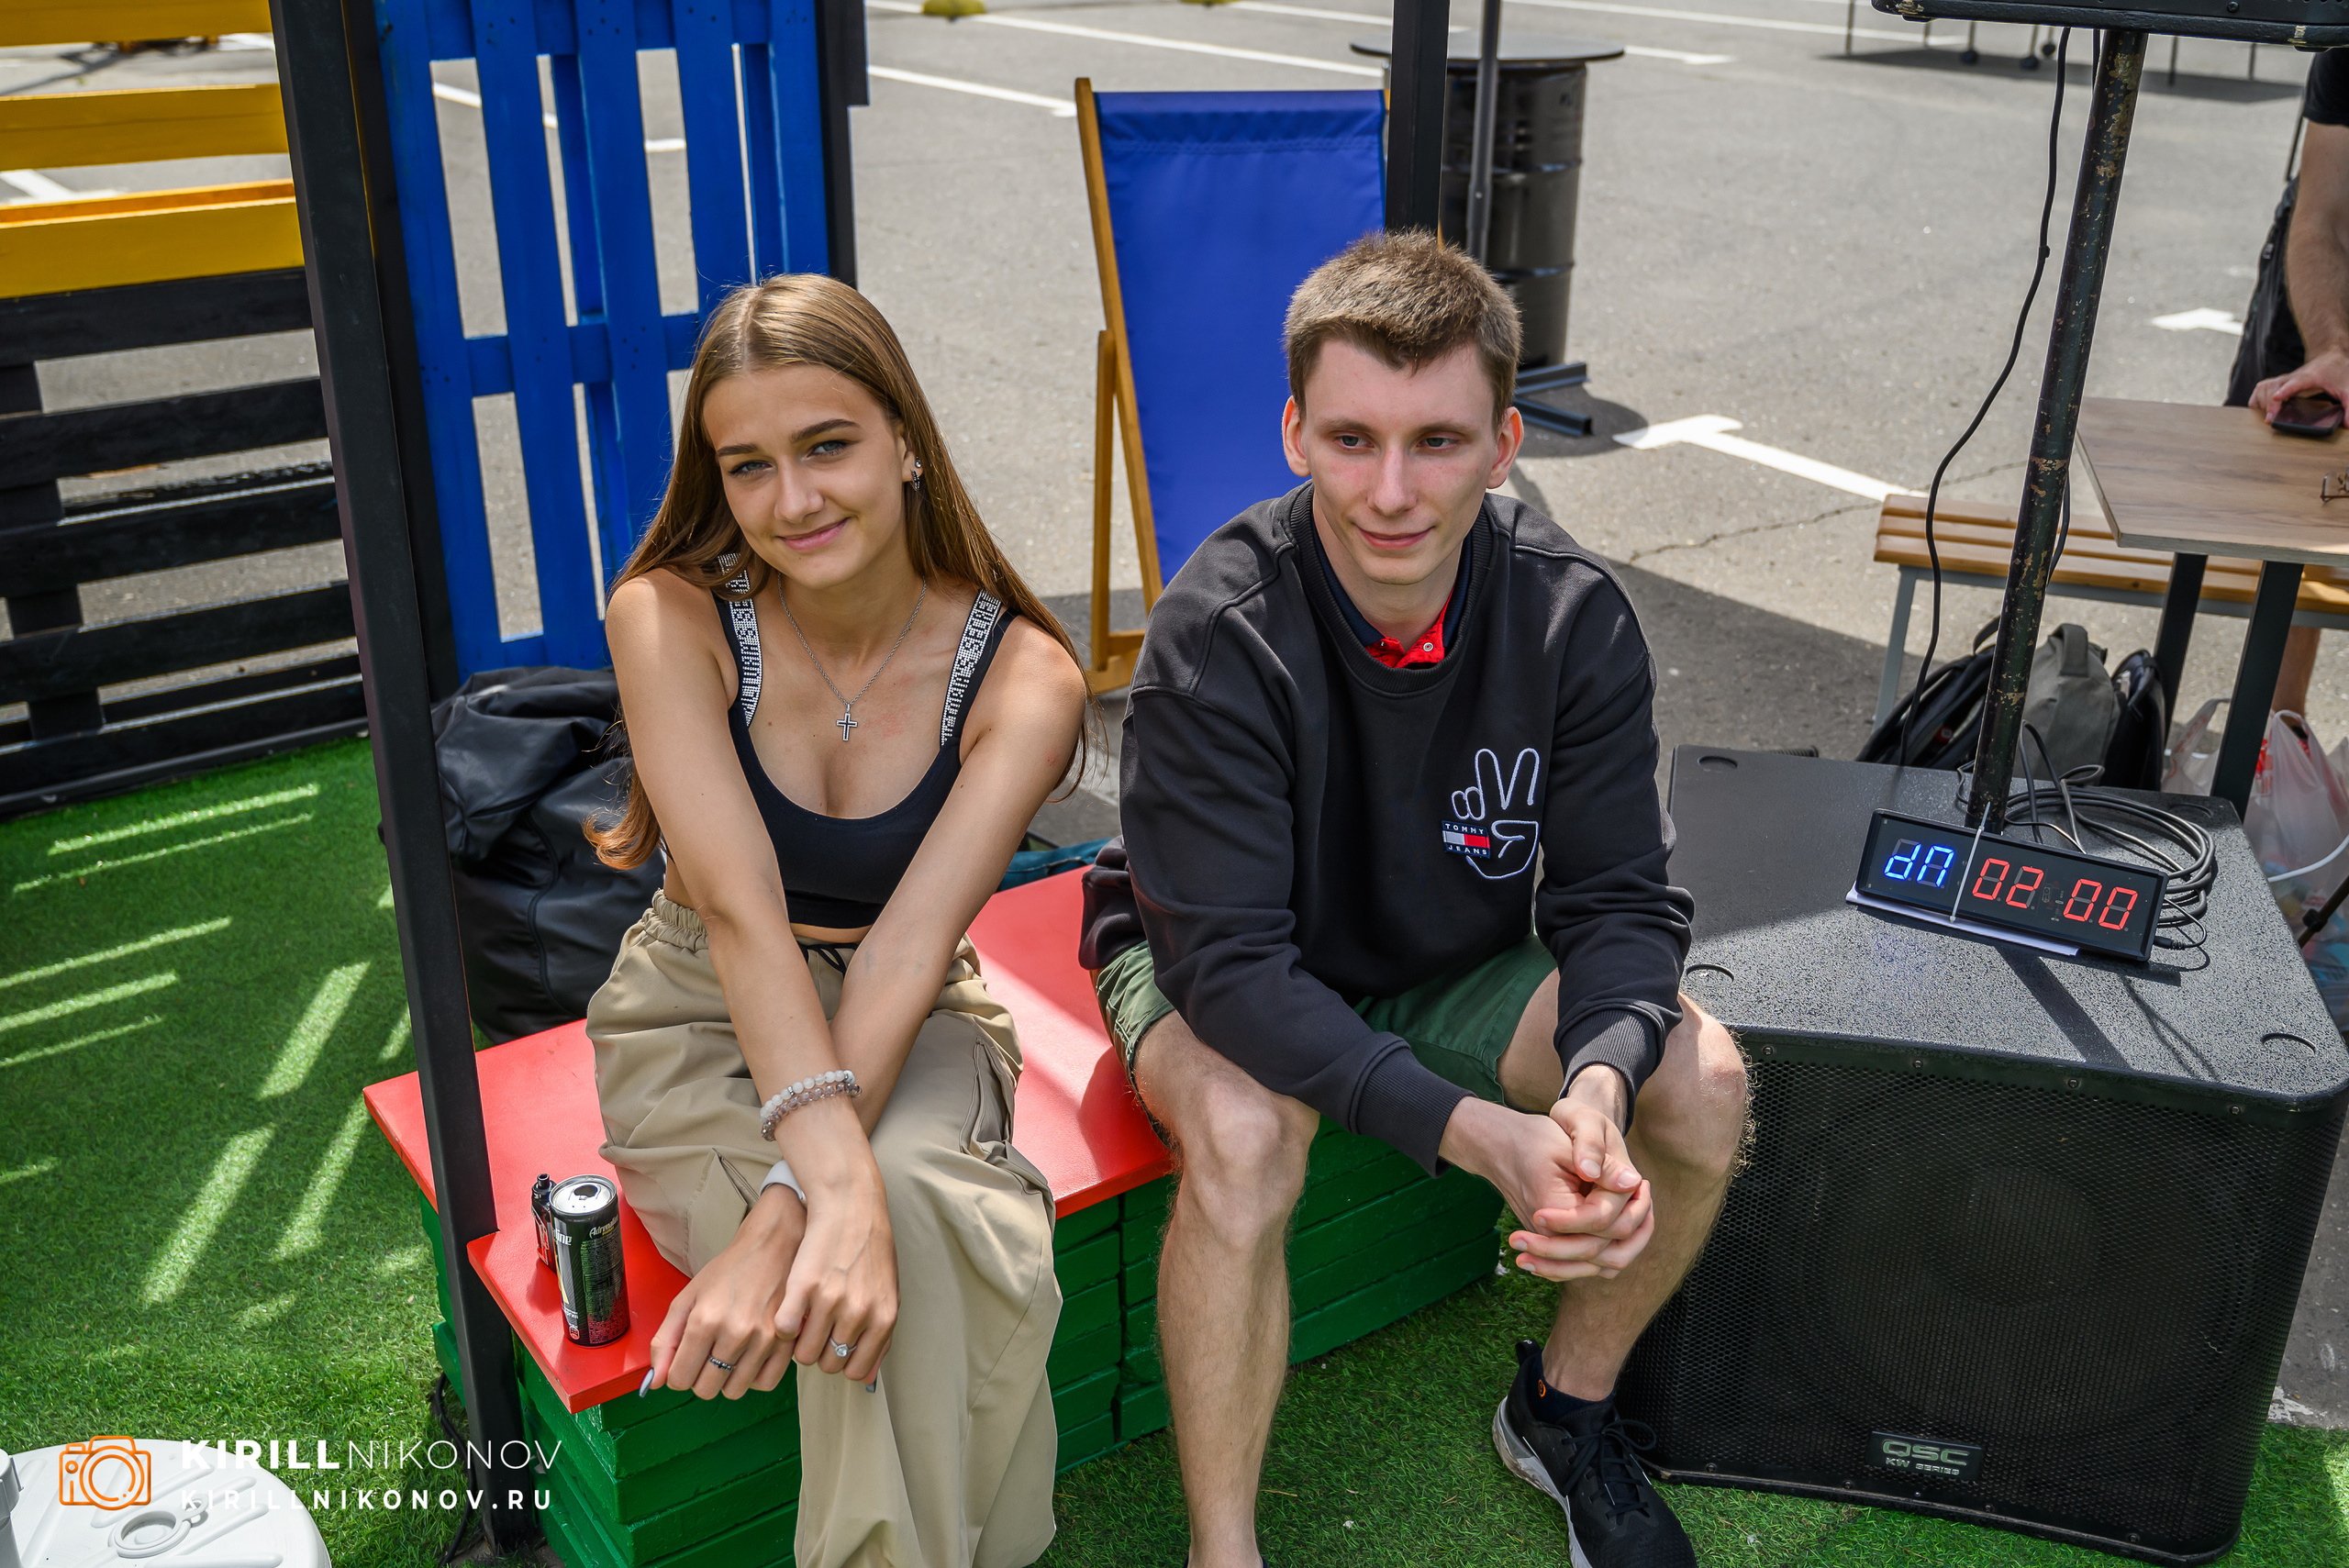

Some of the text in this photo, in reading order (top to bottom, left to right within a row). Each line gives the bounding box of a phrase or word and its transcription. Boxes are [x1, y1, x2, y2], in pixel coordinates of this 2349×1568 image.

[1445, 823, 1484, 834] TOMMY
[1448, 845, 1487, 855] JEANS
[1882, 1440, 1970, 1466] QSC
[1886, 1457, 1960, 1475] KW SERIES
